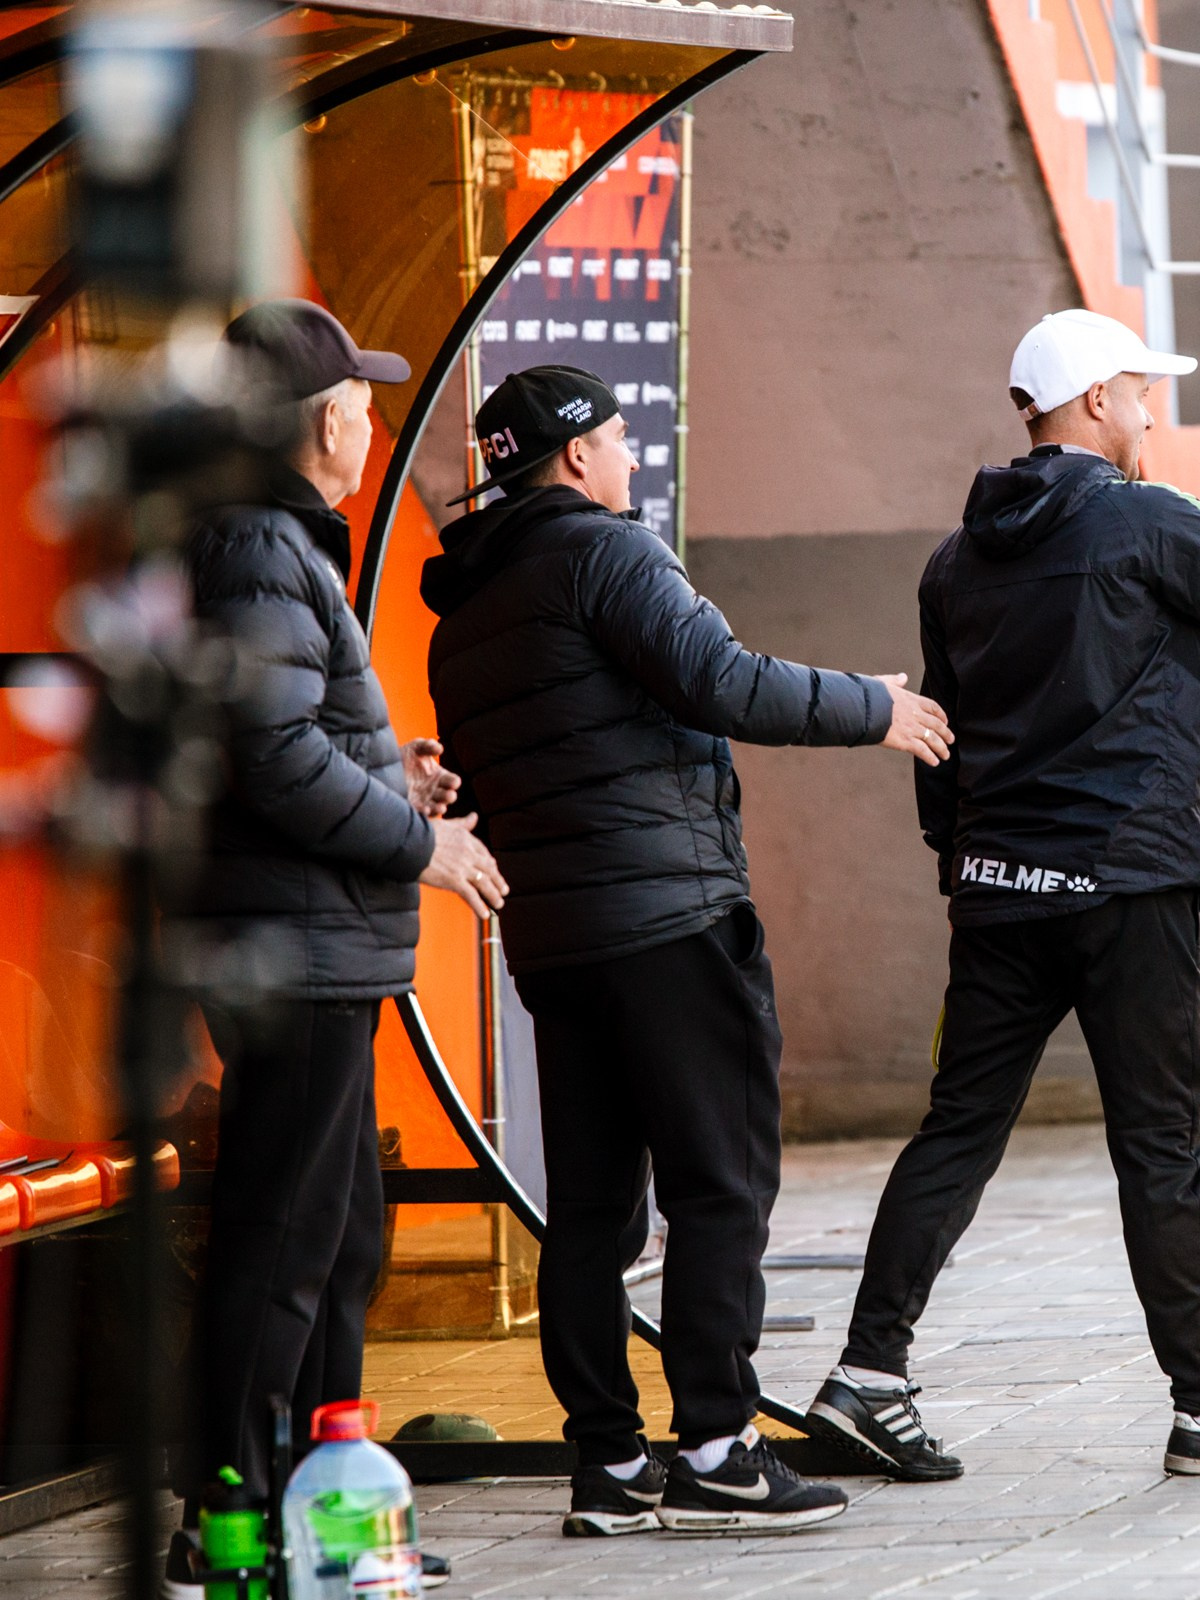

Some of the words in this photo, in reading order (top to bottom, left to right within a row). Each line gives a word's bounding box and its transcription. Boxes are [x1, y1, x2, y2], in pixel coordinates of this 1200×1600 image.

[557, 402, 577, 417] BORN
[575, 410, 592, 423] LAND
[960, 855, 1066, 893] KELME
